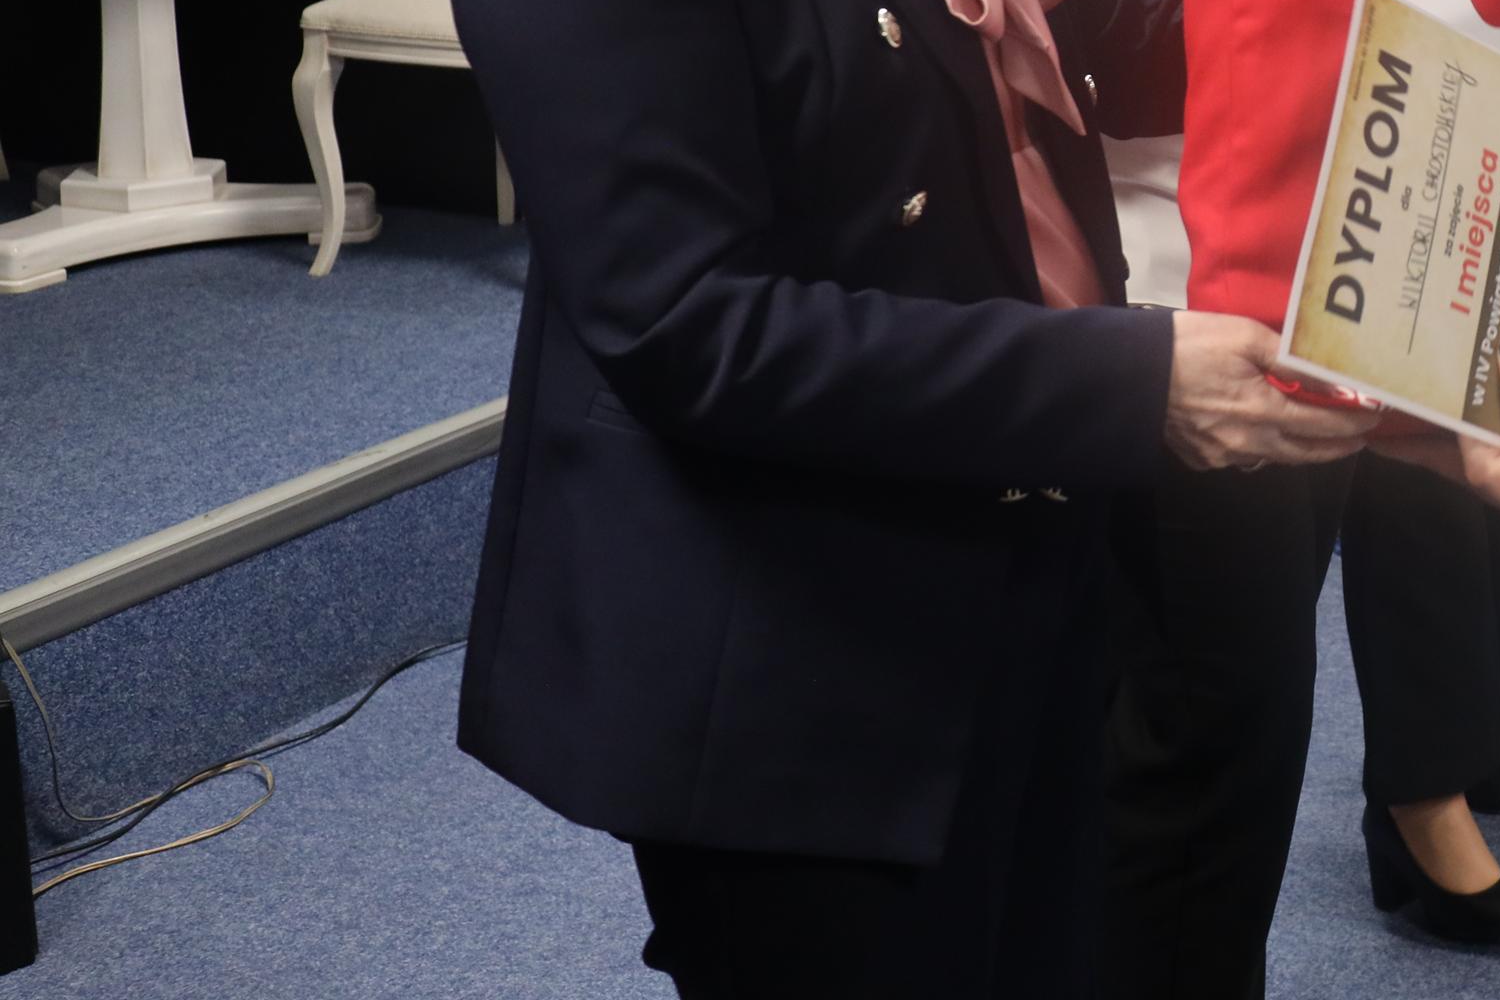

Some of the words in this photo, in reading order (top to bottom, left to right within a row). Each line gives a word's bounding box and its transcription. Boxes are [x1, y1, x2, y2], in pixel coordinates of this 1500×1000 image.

[1324, 49, 1413, 325] DYPLOM
[1401, 185, 1412, 211] dla
[1444, 239, 1454, 256] za
[1449, 183, 1464, 238] zajęcie
[1458, 147, 1499, 297] miejsca
[1450, 301, 1471, 315] I
[1475, 355, 1491, 382] IV
[1472, 383, 1486, 405] w
